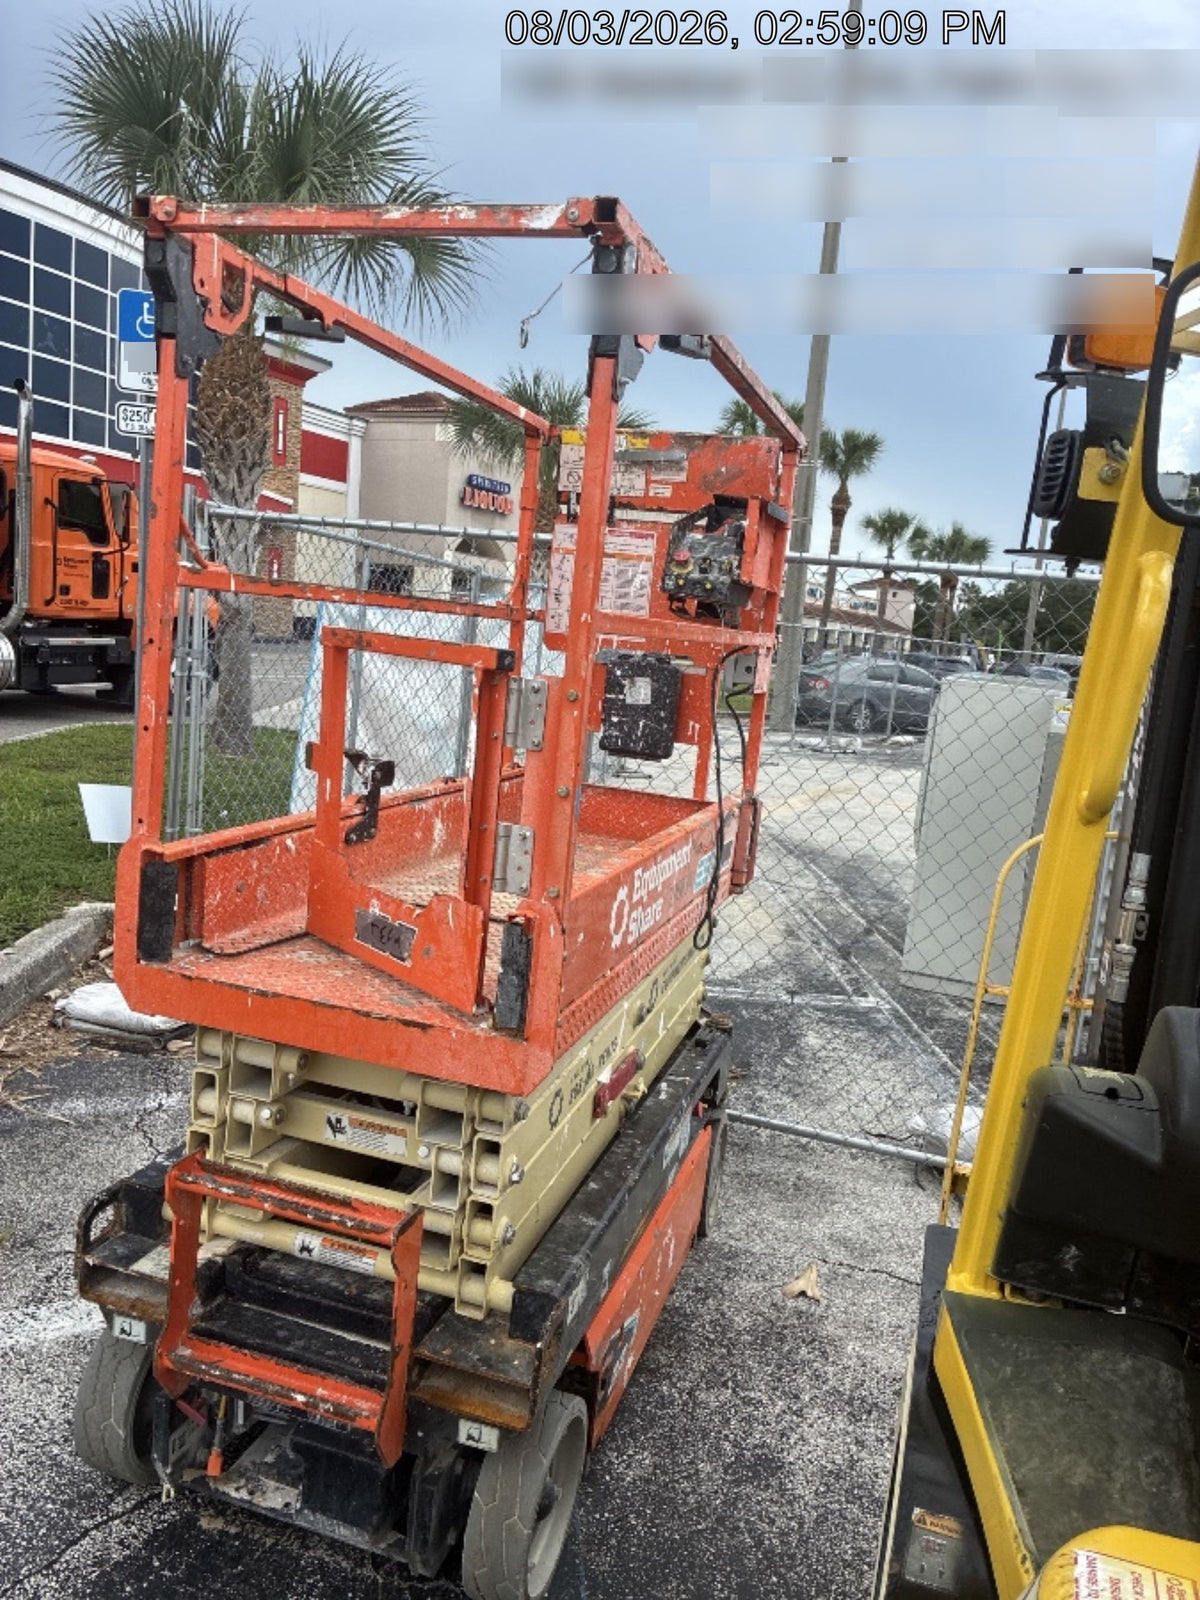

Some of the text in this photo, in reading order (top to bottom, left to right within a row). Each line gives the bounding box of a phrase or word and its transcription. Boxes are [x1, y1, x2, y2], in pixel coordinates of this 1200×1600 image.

[122, 407, 150, 423] $250
[633, 834, 693, 904] Equipment
[627, 898, 664, 945] Share
